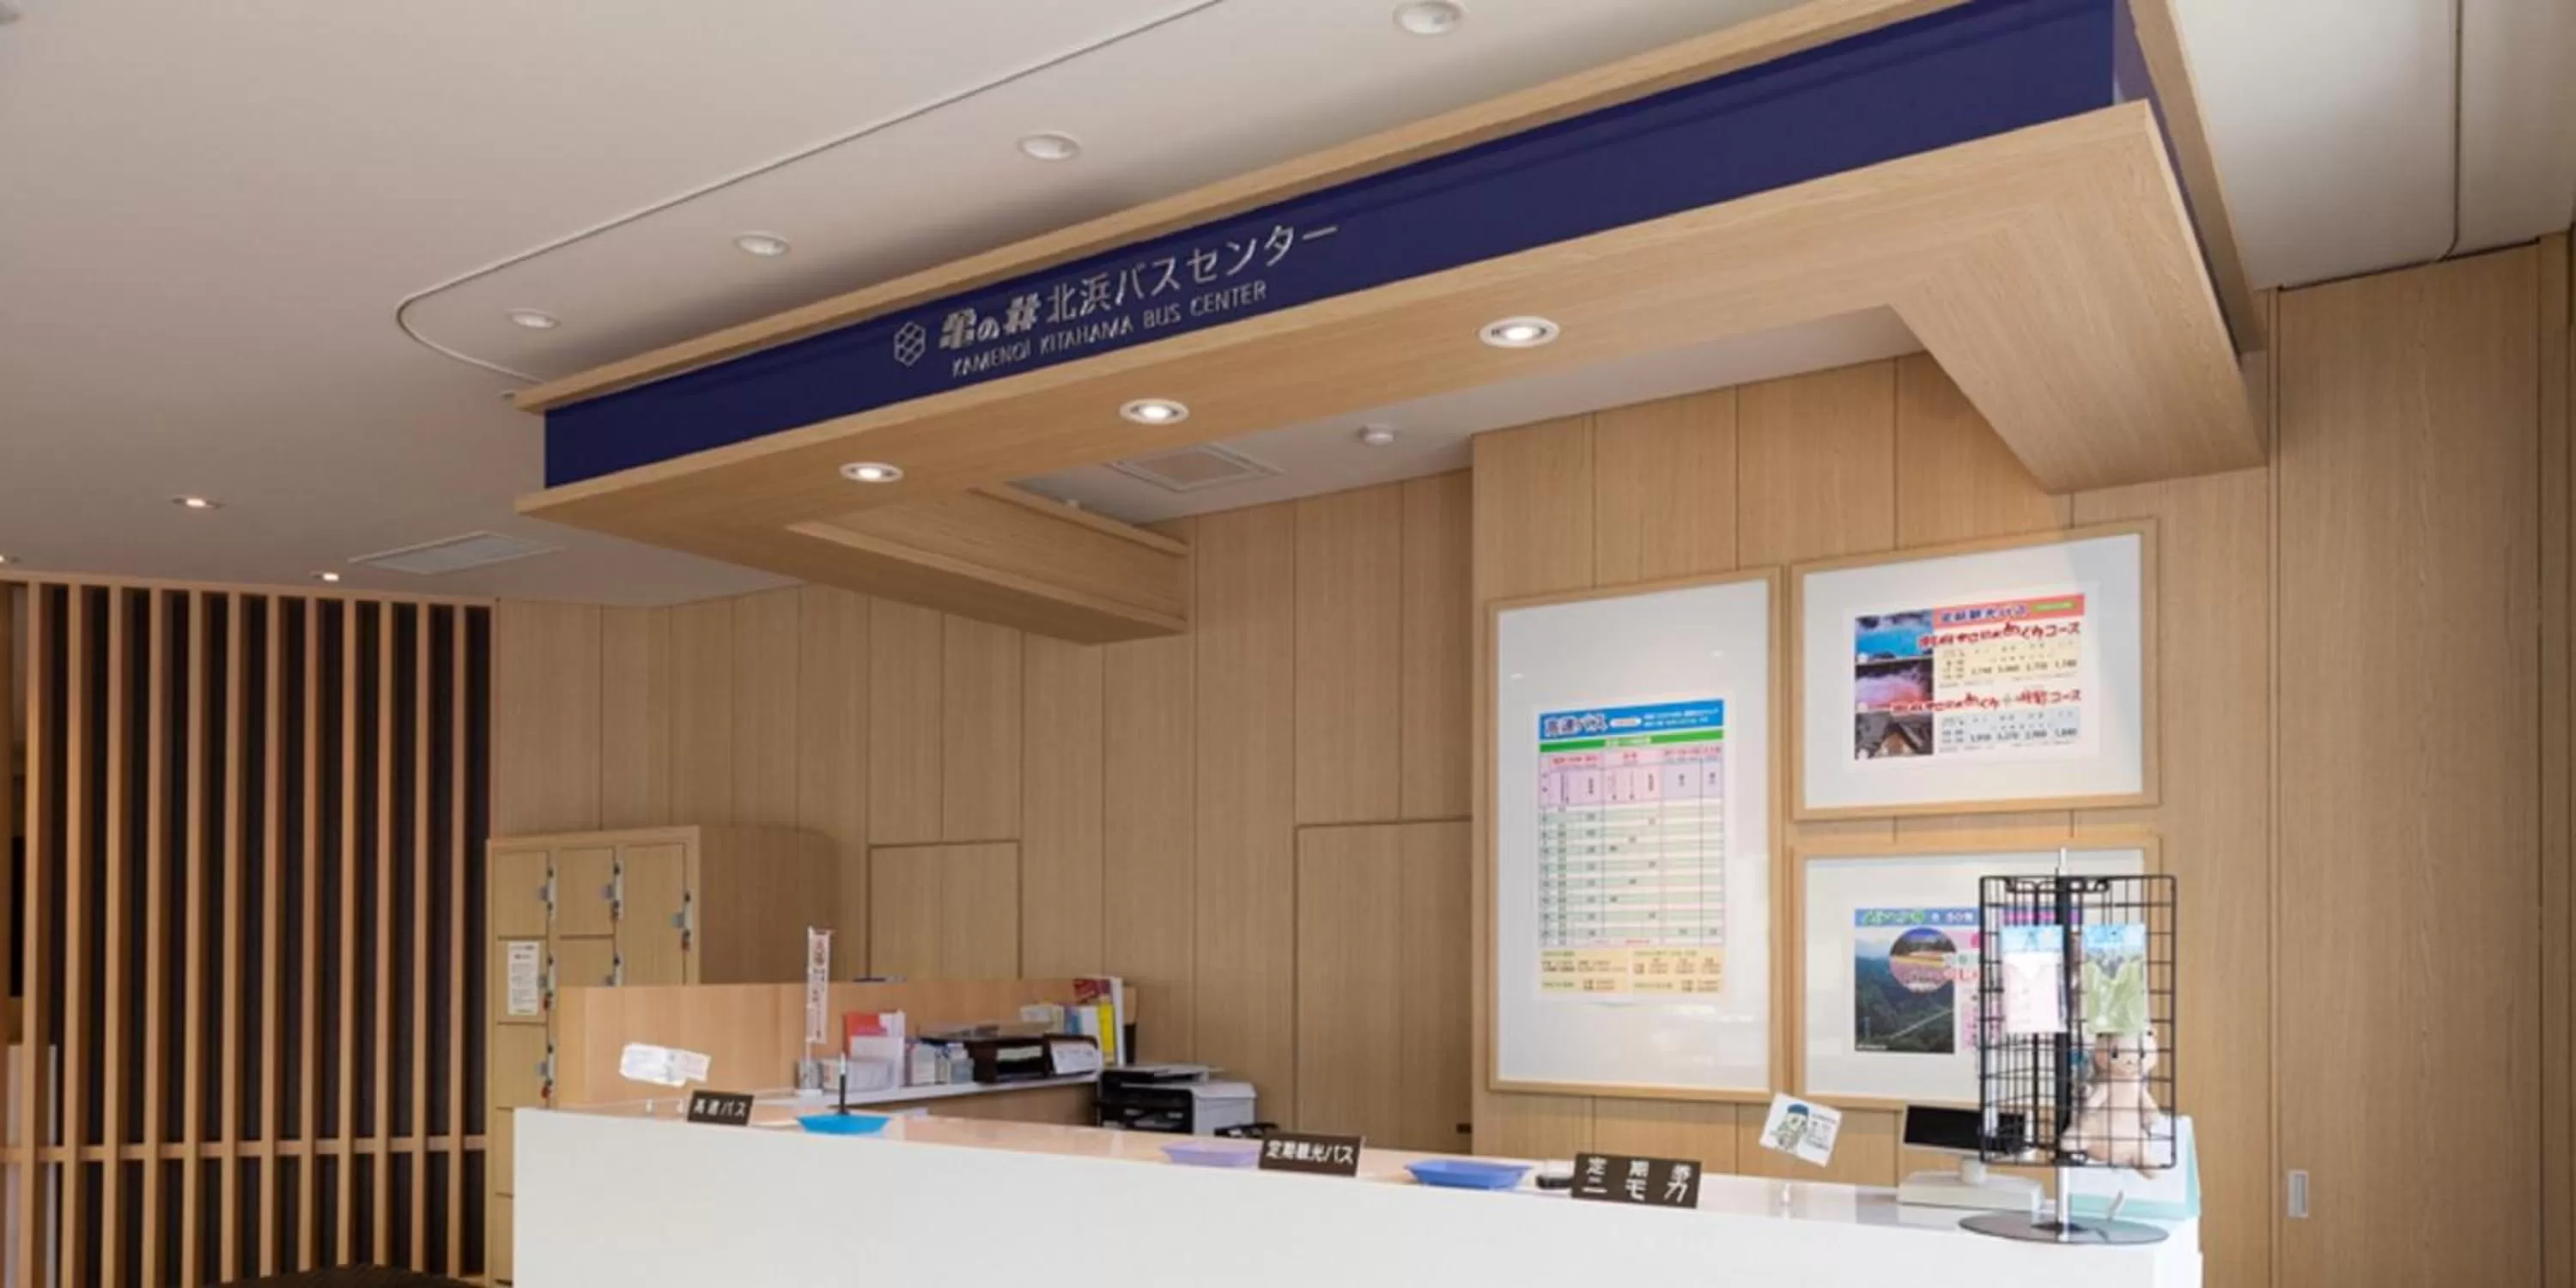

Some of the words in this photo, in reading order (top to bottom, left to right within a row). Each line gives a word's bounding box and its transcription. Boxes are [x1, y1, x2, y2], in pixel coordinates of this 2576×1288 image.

[951, 339, 1031, 378] KAMENOI
[1040, 315, 1134, 355] KITAHAMA
[1143, 303, 1182, 329] BUS
[1190, 279, 1267, 316] CENTER
[1265, 1139, 1354, 1165] 定期観光バス
